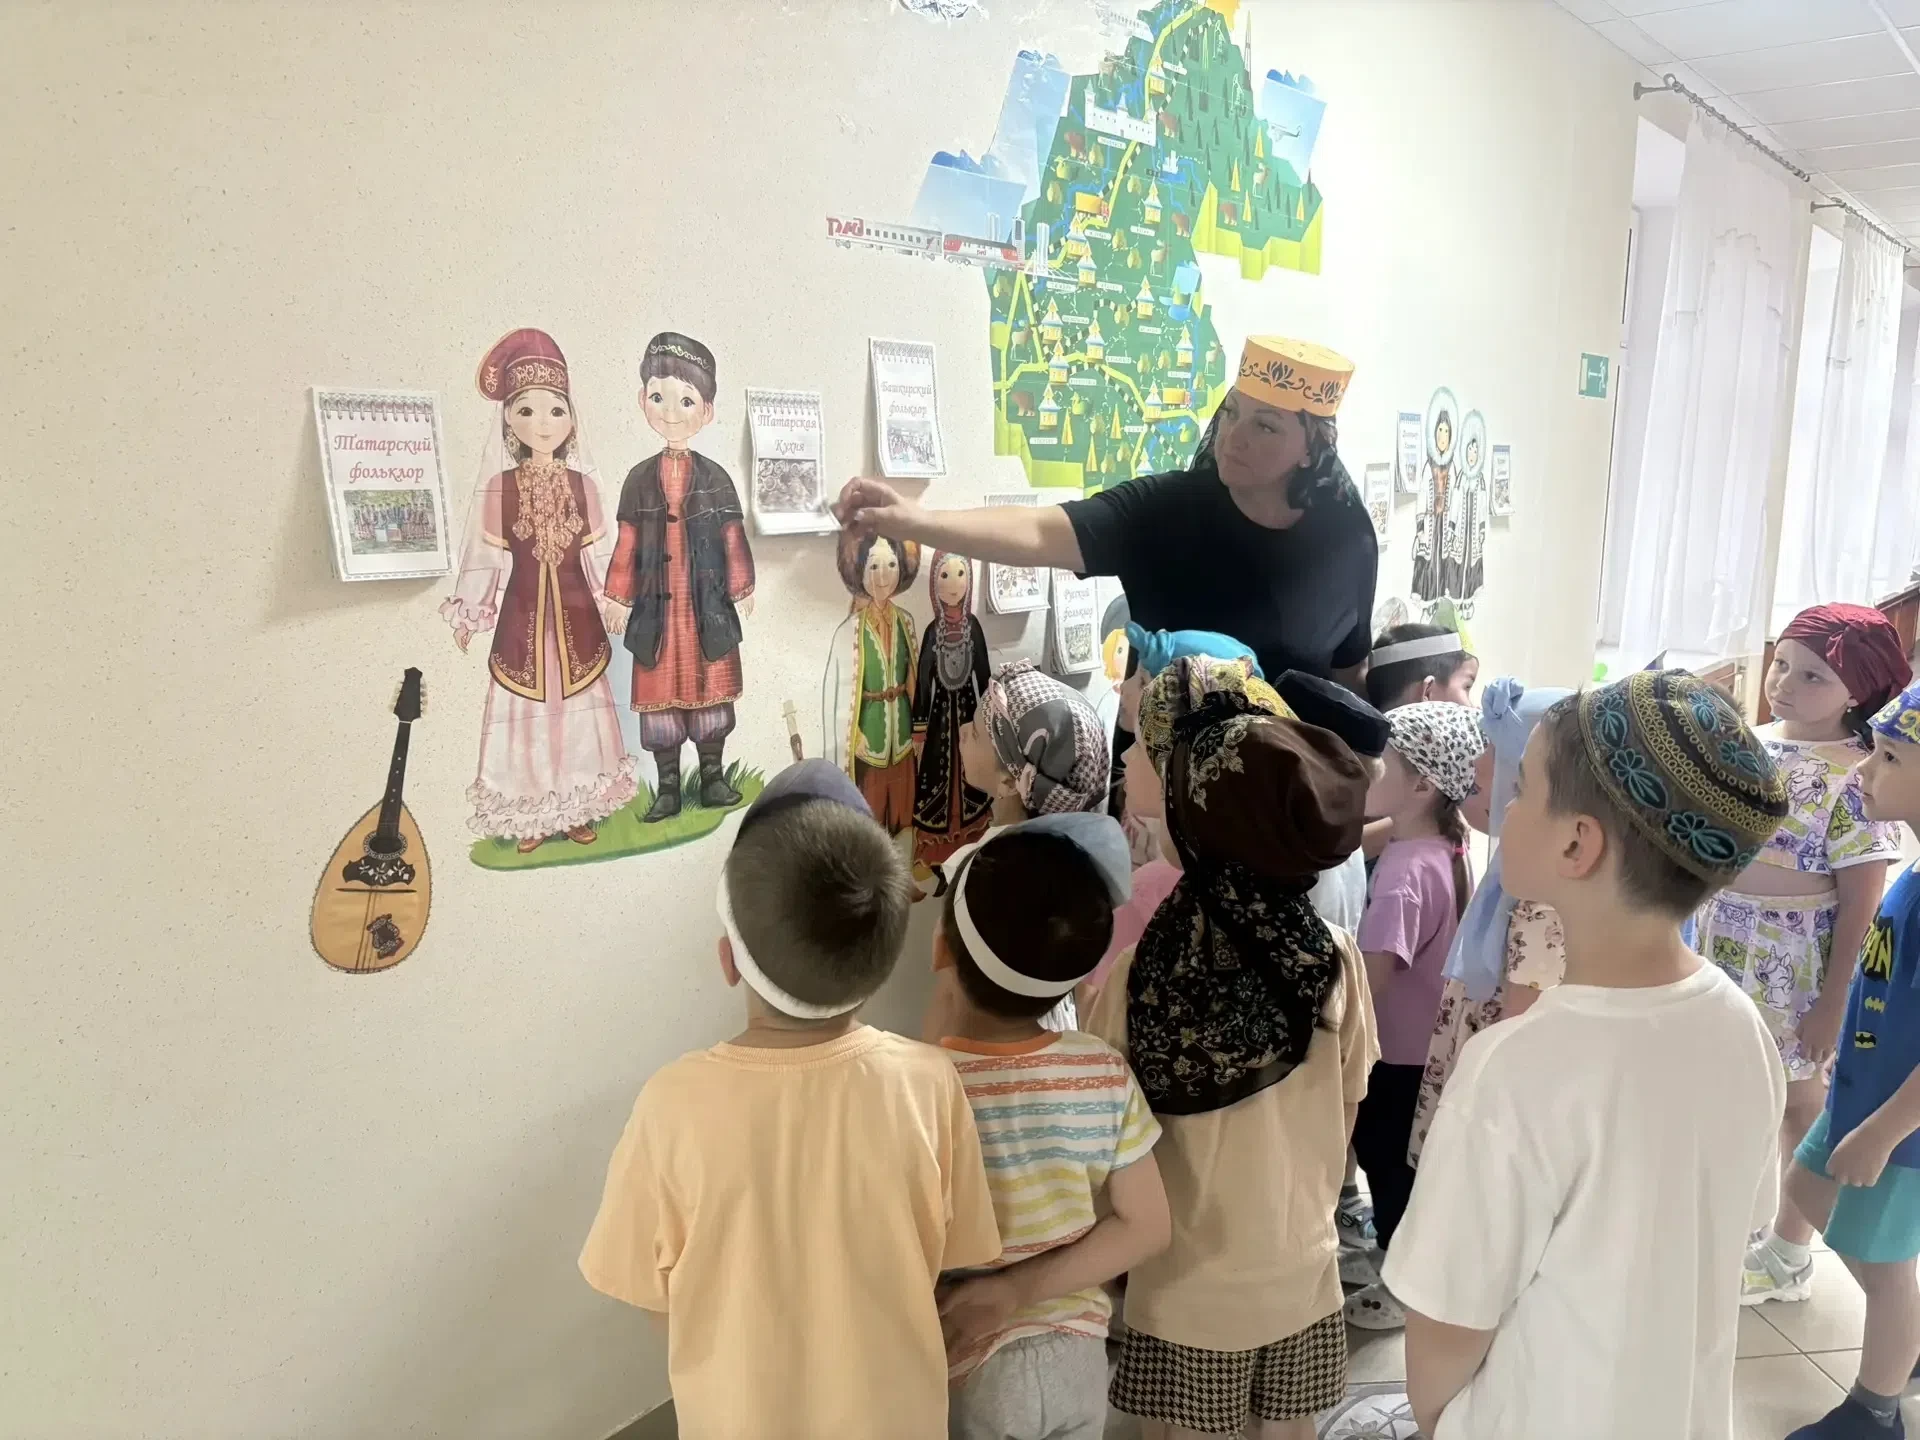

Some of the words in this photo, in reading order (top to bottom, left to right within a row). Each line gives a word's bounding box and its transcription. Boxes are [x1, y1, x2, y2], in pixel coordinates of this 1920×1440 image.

[880, 381, 932, 398] Башкирский
[888, 400, 927, 419] фольклор
[757, 414, 817, 432] Татарская
[334, 434, 432, 456] Татарский
[775, 439, 805, 456] Кухня
[349, 461, 424, 484] фольклор
